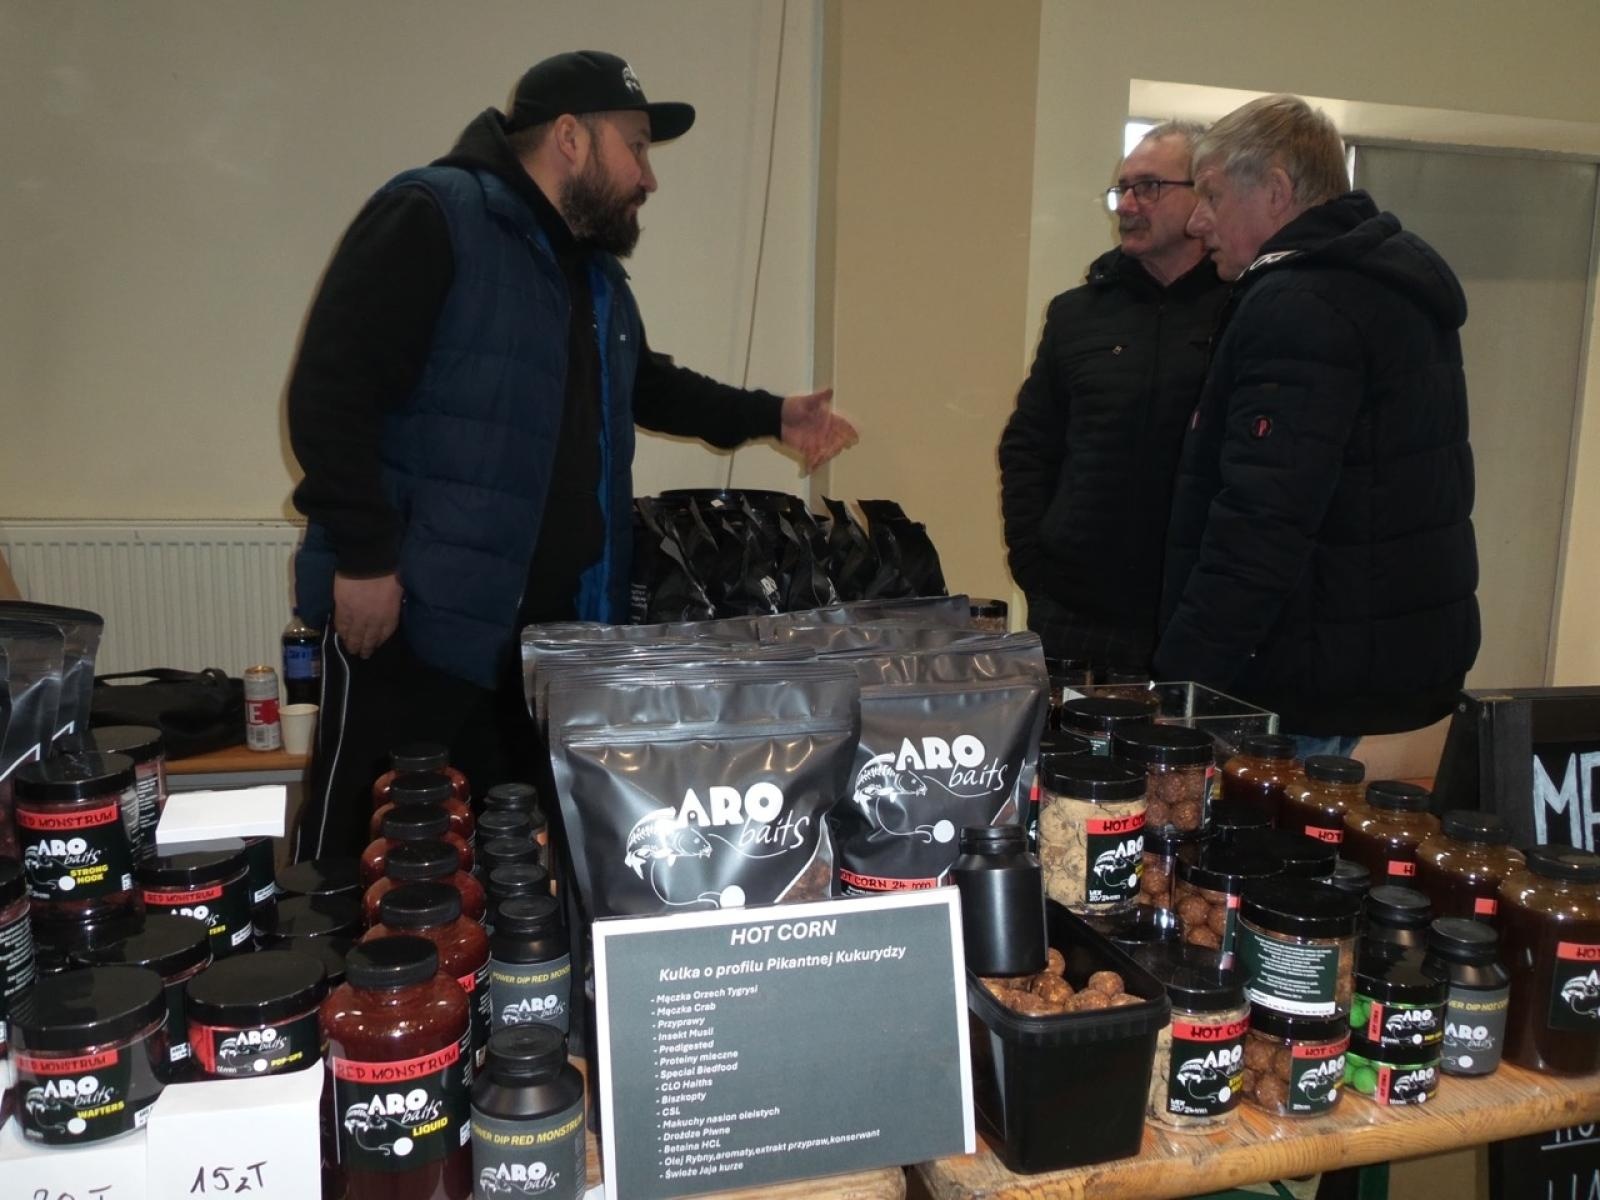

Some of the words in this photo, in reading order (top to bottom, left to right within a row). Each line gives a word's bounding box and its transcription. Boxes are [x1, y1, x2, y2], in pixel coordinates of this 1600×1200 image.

[895, 734, 985, 770] ARO
[949, 757, 1008, 791] baits
[39, 810, 113, 828] MONSTRUM
[678, 782, 784, 827] ARO
[739, 810, 810, 849] baits
[1103, 820, 1130, 831] HOT
[1319, 830, 1341, 842] HOT
[38, 837, 87, 856] ARO
[64, 848, 101, 865] baits
[1115, 835, 1144, 858] ARO
[70, 864, 109, 877] STRONG
[76, 873, 104, 884] HOOK
[855, 876, 887, 888] CORN
[730, 925, 774, 946] HOT
[777, 919, 837, 942] CORN
[659, 967, 700, 982] Kulka
[704, 967, 712, 977] o
[716, 959, 763, 979] profilu
[767, 953, 833, 971] Pikantnej
[836, 945, 906, 963] Kukurydzy
[531, 974, 549, 984] RED
[693, 988, 726, 1000] Orzech
[519, 994, 558, 1011] ARO
[694, 1002, 716, 1012] Crab
[1402, 1009, 1433, 1022] ARO
[657, 1017, 706, 1029] Przyprawy
[236, 1028, 277, 1045] ARO
[658, 1030, 687, 1041] Insekt
[689, 1027, 714, 1038] Musli
[1191, 1025, 1222, 1038] HOT
[1445, 1022, 1488, 1040] ARO
[659, 1040, 715, 1054] Predigested
[40, 1056, 106, 1071] MONSTRUM
[659, 1054, 699, 1067] Proteiny
[1203, 1045, 1243, 1069] ARO
[336, 1063, 365, 1080] RED
[372, 1049, 457, 1080] MONSTRUM
[1318, 1055, 1345, 1076] ARO
[660, 1067, 696, 1080] Special
[1410, 1067, 1435, 1082] ARO
[44, 1075, 99, 1099] ARO
[661, 1081, 680, 1091] CLO
[661, 1092, 707, 1104] Biszkopty
[77, 1100, 125, 1119] WAFTERS
[368, 1088, 428, 1115] ARO
[401, 1099, 442, 1124] baits
[662, 1106, 681, 1116] CSL
[413, 1116, 448, 1137] LIQUID
[663, 1117, 706, 1129] Makuchy
[494, 1134, 510, 1145] DIP
[511, 1134, 534, 1146] RED
[664, 1143, 700, 1154] Betaina
[701, 1139, 721, 1149] HCL
[664, 1155, 684, 1166] Olej
[719, 1162, 744, 1172] kurze
[496, 1161, 547, 1181] ARO
